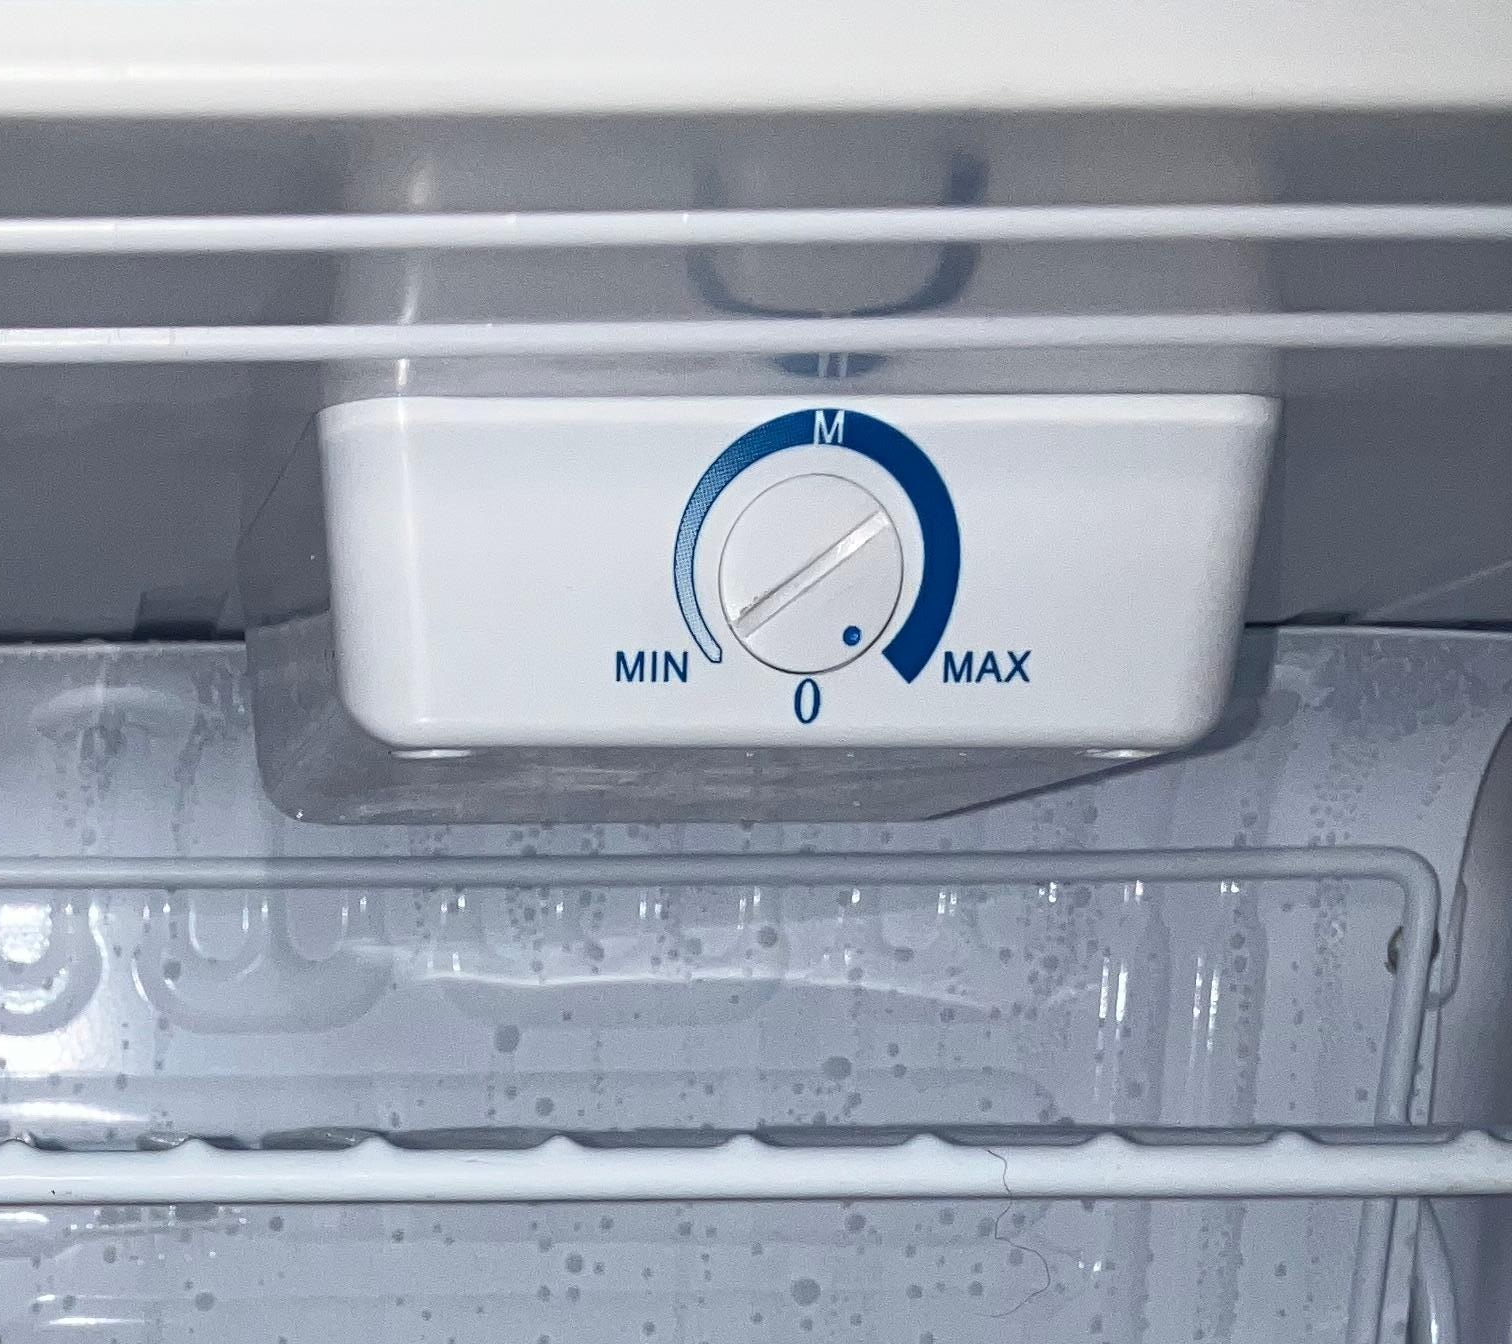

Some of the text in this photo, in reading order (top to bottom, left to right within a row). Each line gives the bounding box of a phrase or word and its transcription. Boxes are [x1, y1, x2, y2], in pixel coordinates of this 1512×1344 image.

[813, 410, 845, 446] M
[615, 650, 689, 683] MIN
[942, 650, 1032, 683] MAX
[793, 677, 822, 724] 0
